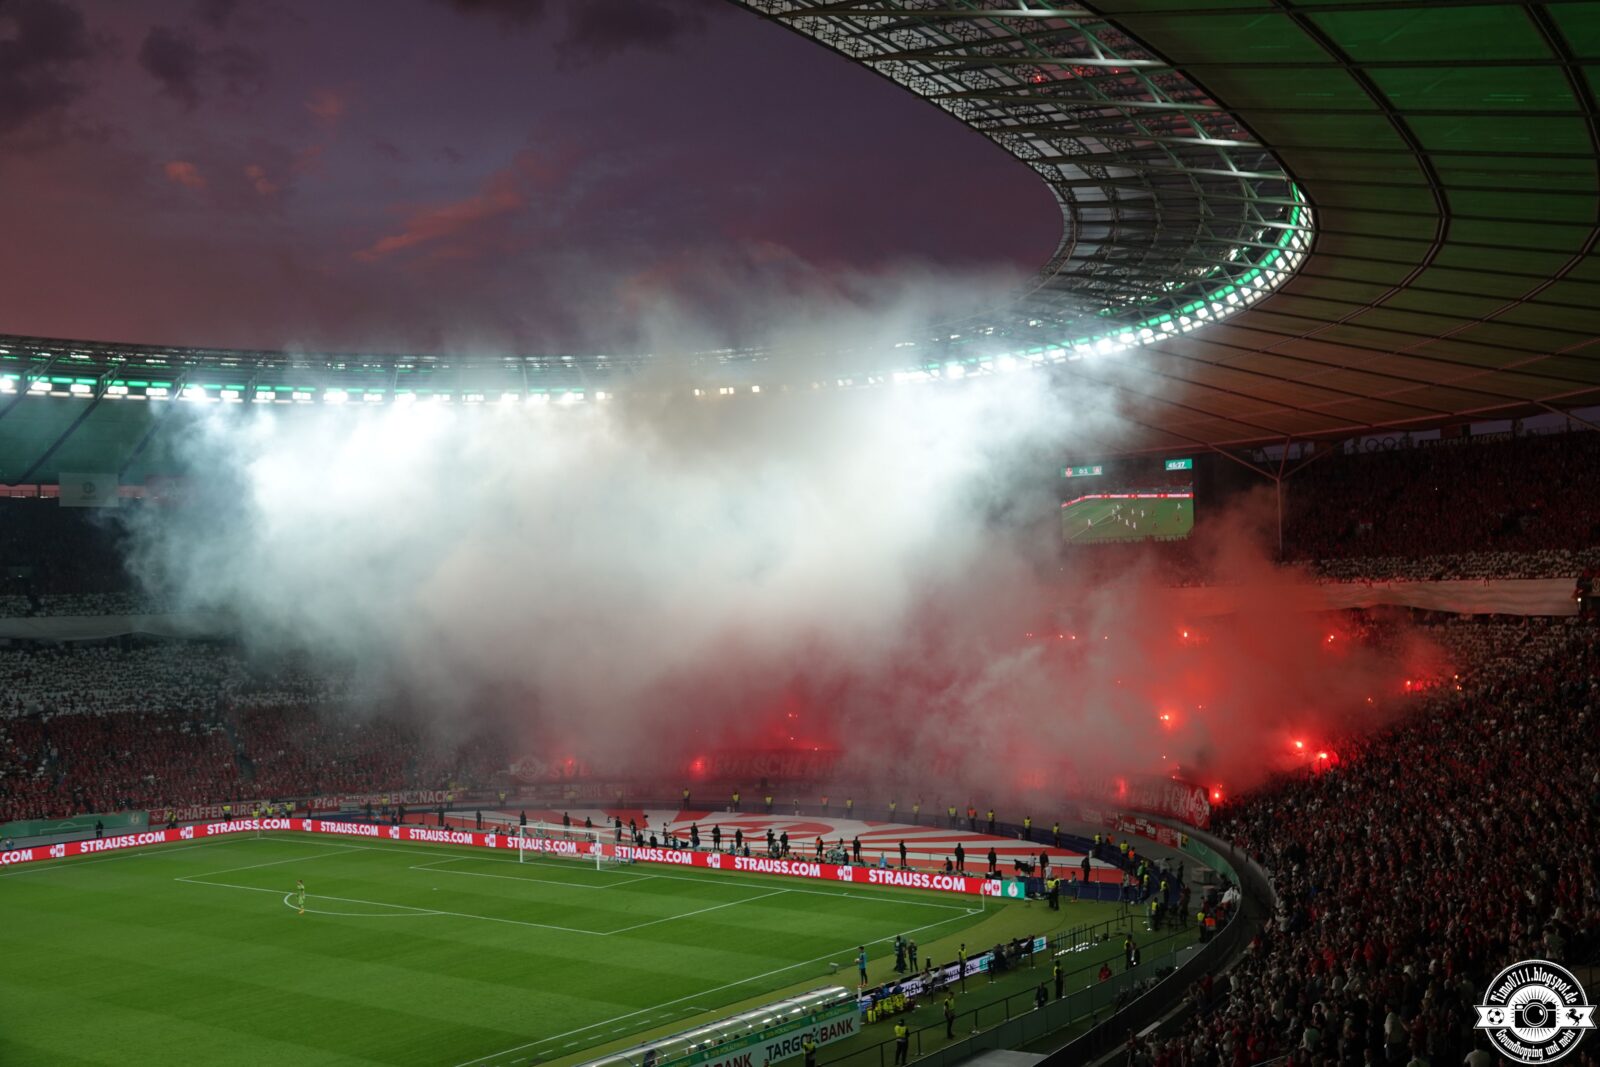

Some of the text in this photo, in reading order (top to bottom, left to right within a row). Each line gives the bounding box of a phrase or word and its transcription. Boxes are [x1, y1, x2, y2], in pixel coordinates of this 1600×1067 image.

[207, 818, 291, 835] STRAUSS.COM
[320, 821, 379, 837] STRAUSS.COM
[80, 831, 166, 853] STRAUSS.COM
[409, 828, 473, 845] STRAUSS.COM
[734, 859, 821, 877] STRAUSS.COM
[868, 869, 966, 892] STRAUSS.COM
